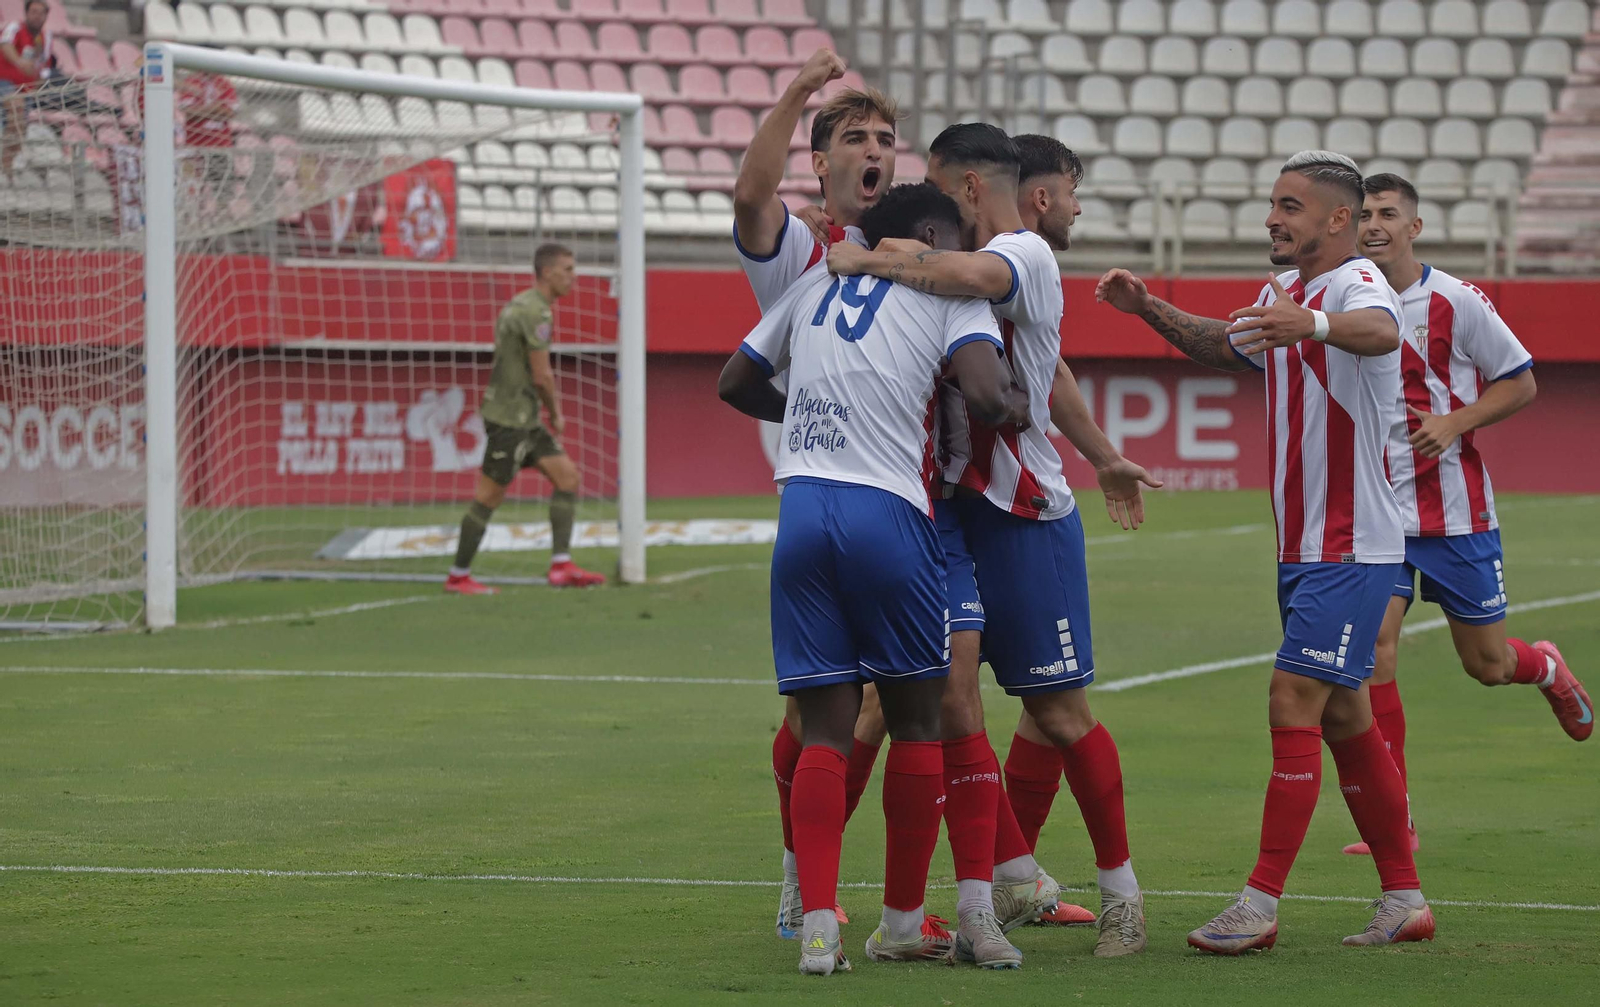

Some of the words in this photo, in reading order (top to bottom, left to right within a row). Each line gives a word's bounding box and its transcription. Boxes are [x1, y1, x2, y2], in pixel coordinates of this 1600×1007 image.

[810, 274, 893, 342] 19
[791, 388, 851, 427] Algeciras
[821, 418, 832, 429] me
[804, 421, 848, 452] Gusta
[1301, 647, 1336, 662] capelli
[1029, 660, 1064, 676] capelli
[1273, 771, 1314, 781] capelli
